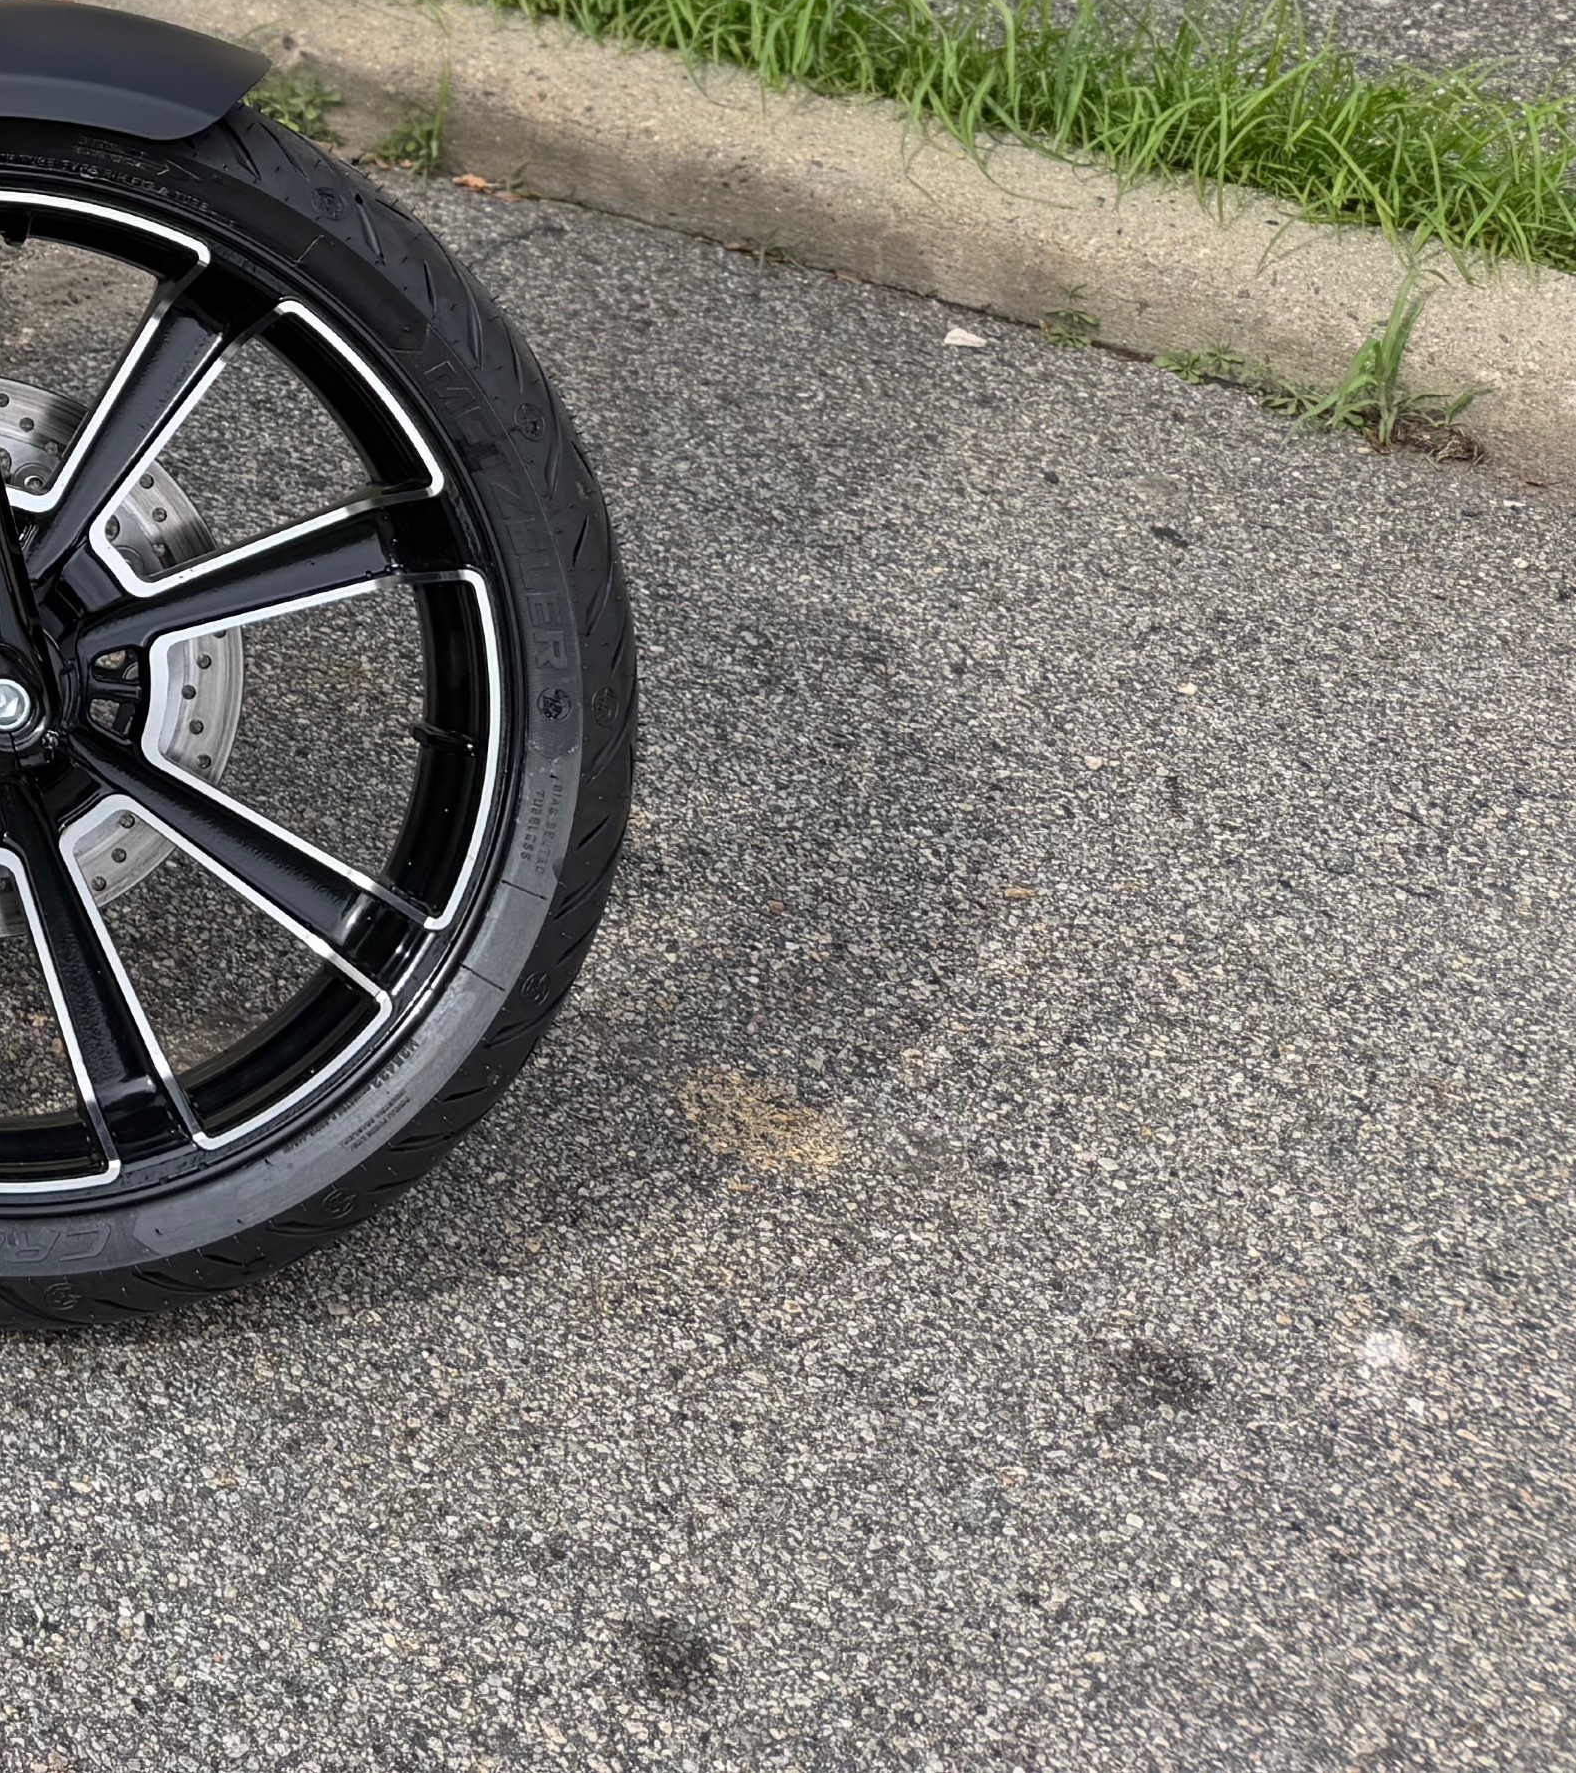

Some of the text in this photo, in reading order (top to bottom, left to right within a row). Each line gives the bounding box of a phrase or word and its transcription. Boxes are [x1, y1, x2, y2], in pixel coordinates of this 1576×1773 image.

[423, 361, 569, 670] METZELER
[519, 789, 545, 861] TUBELESS
[548, 784, 563, 817] BIAS
